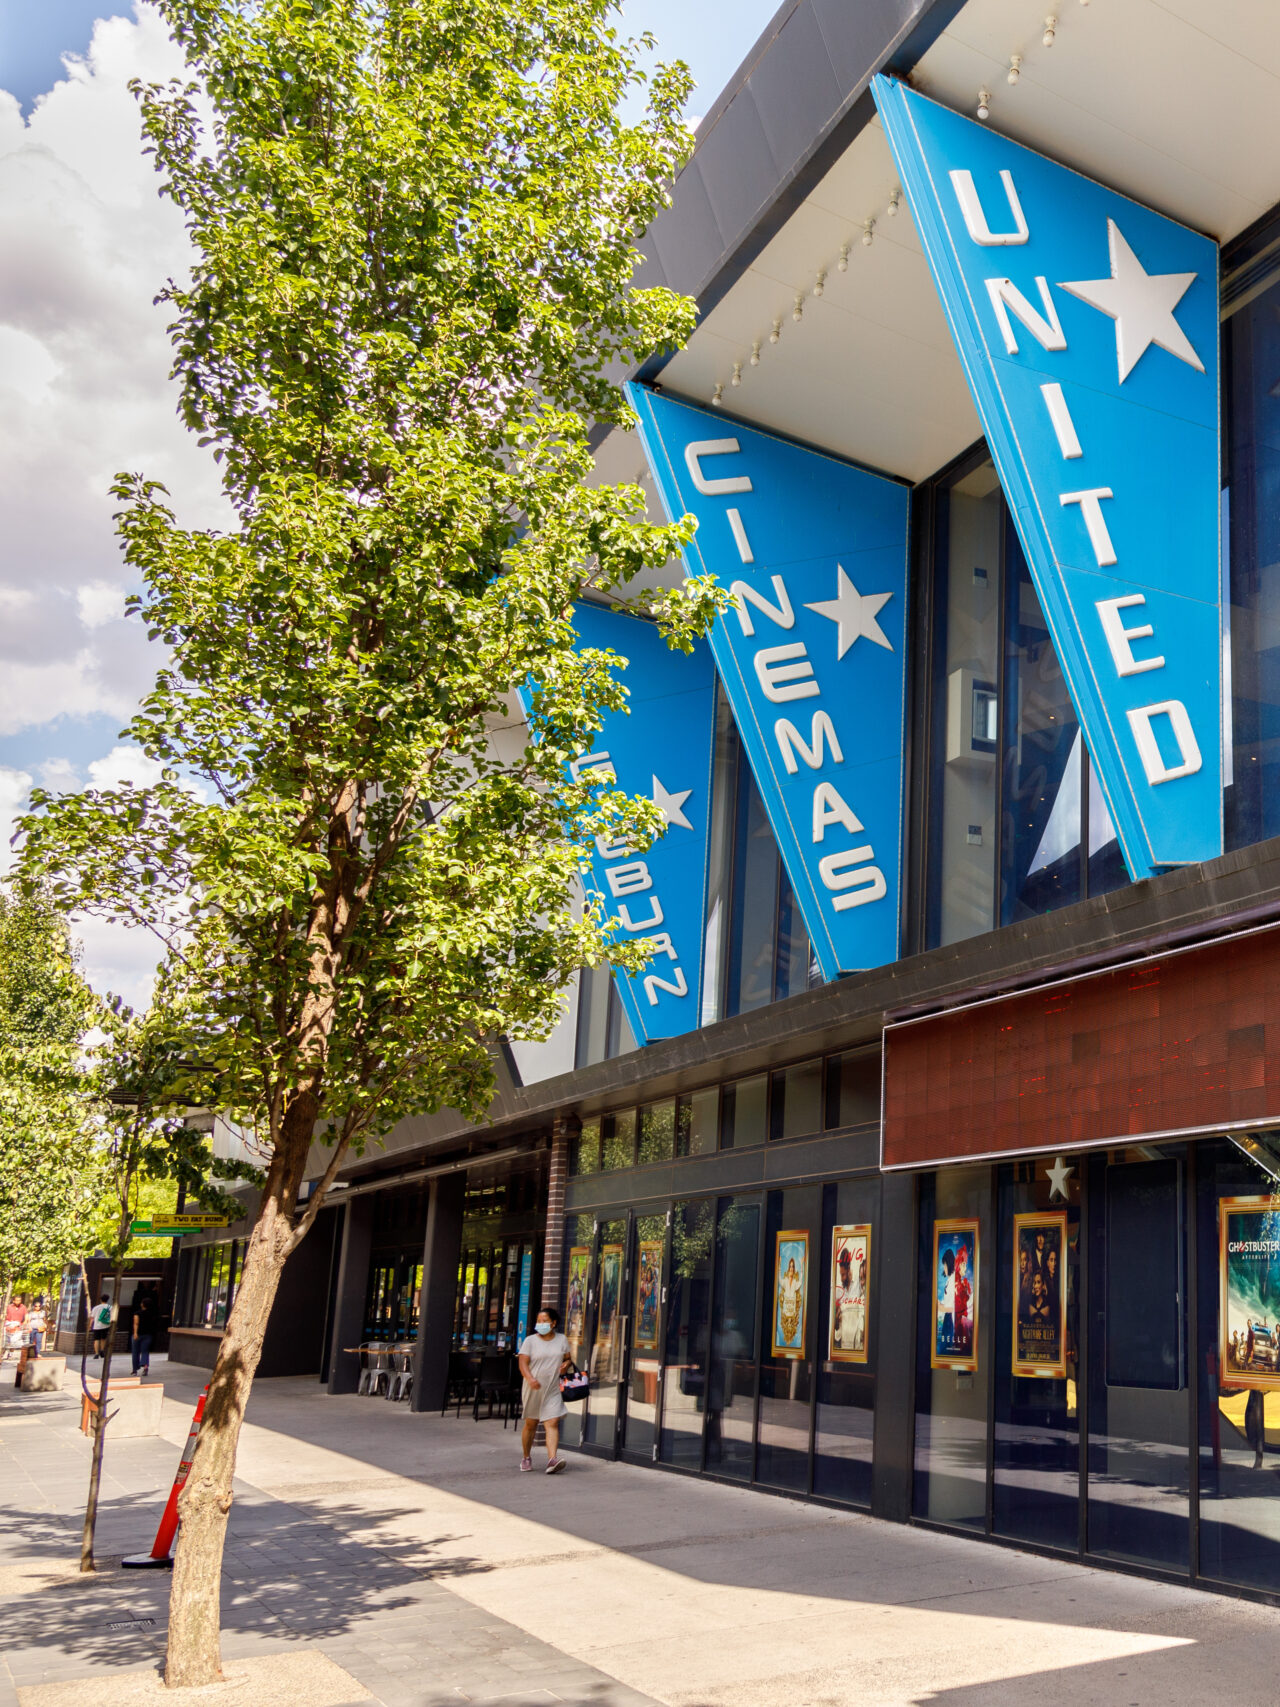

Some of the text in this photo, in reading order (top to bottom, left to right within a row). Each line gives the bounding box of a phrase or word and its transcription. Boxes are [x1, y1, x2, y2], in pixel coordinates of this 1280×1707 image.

[684, 437, 888, 913] CINEMAS
[948, 169, 1202, 788] UNITED
[941, 1335, 967, 1343] BELLE
